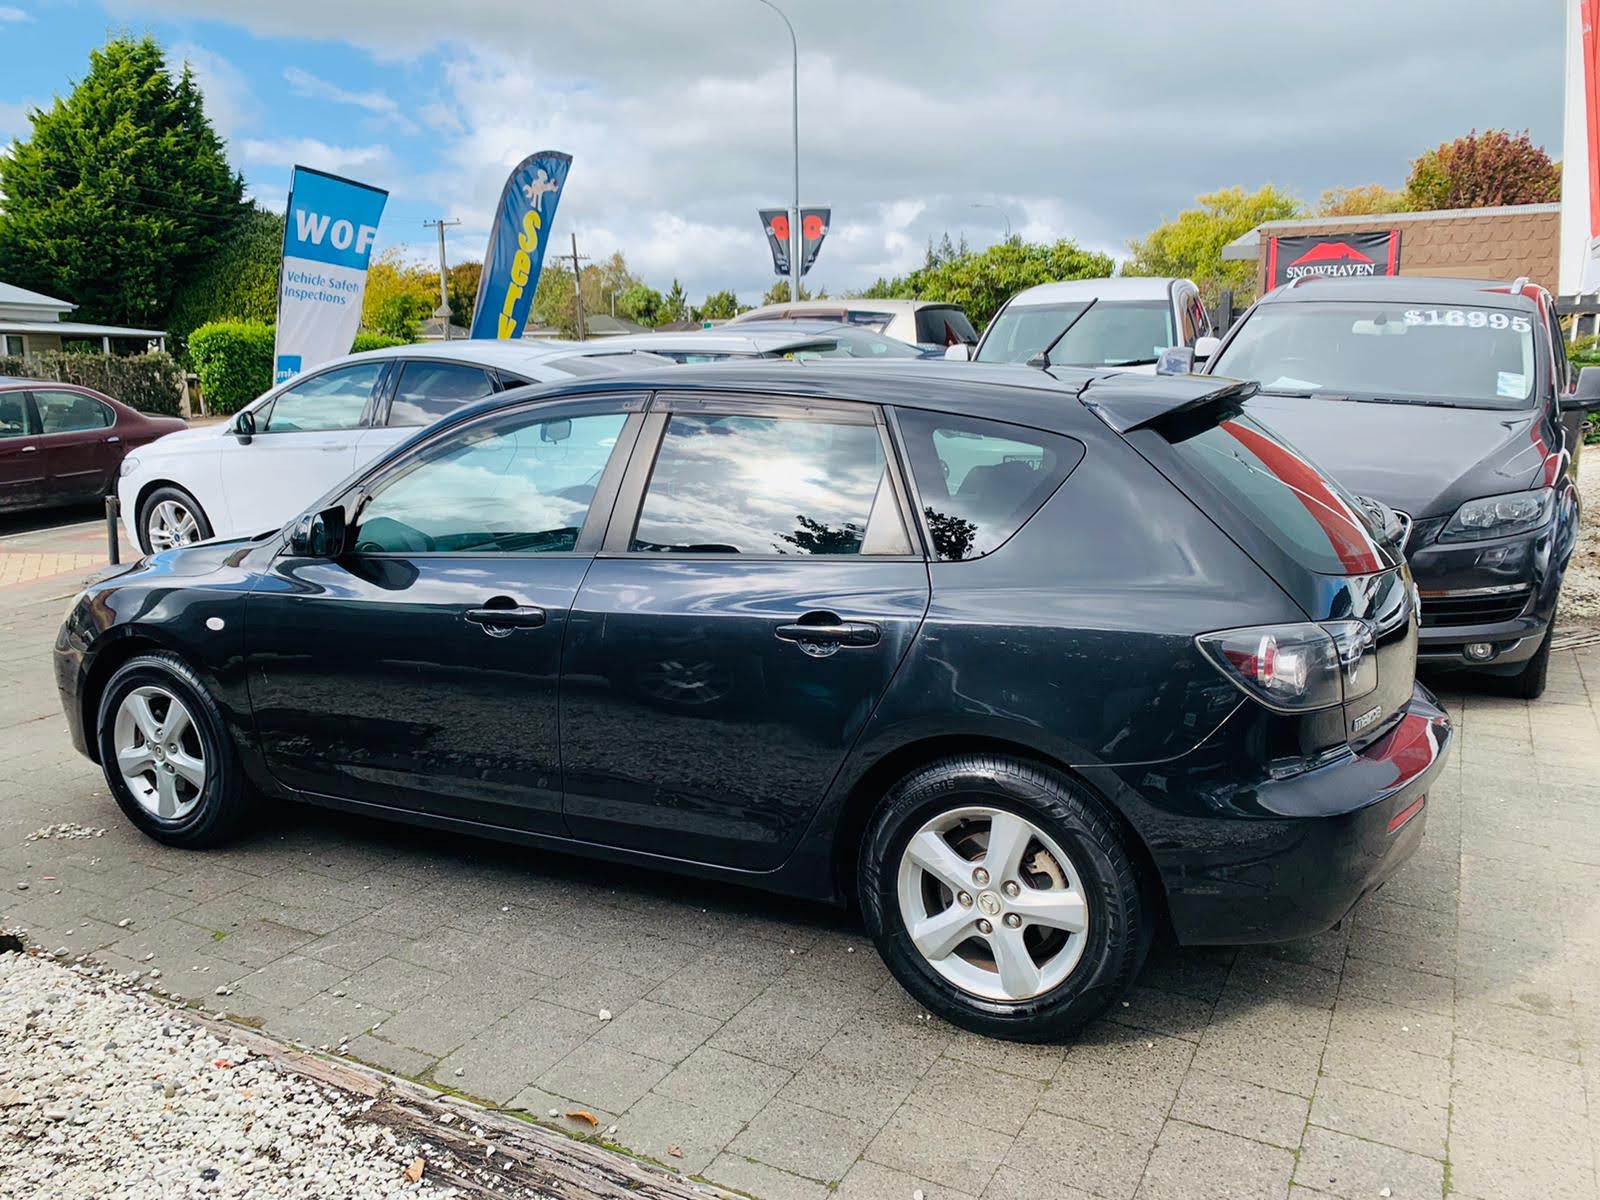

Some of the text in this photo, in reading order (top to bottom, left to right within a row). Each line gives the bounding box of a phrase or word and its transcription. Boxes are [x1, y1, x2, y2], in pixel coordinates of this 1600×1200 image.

[296, 208, 376, 254] WOF
[288, 271, 326, 287] Vehicle
[1286, 263, 1376, 279] SNOWHAVEN
[284, 286, 347, 305] Inspections
[1403, 309, 1532, 333] $16995
